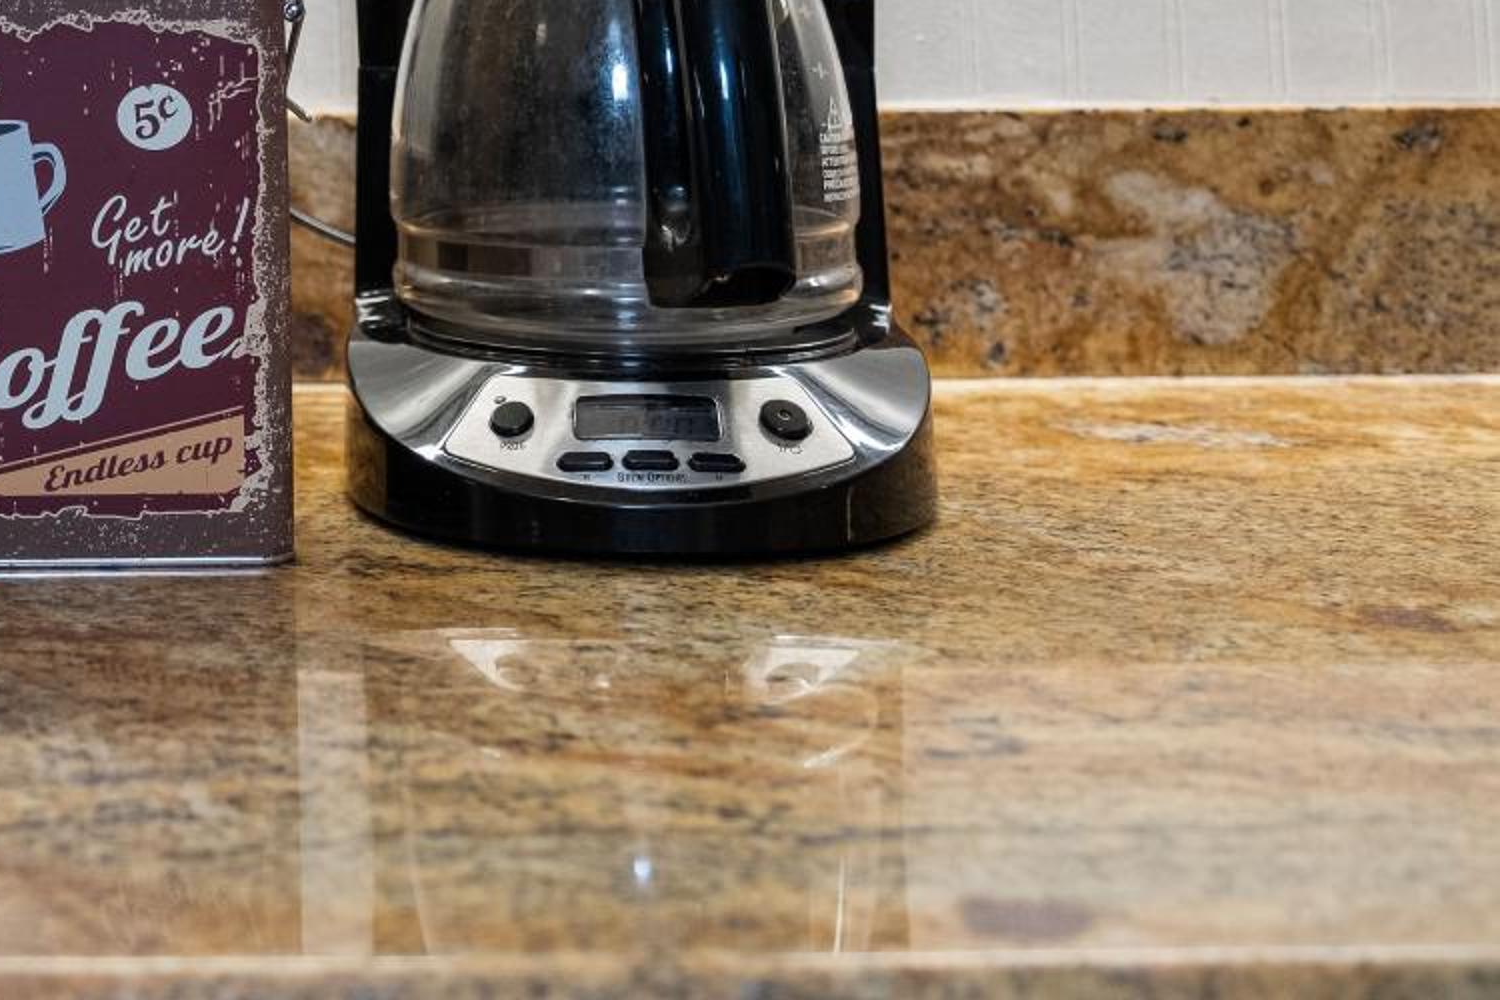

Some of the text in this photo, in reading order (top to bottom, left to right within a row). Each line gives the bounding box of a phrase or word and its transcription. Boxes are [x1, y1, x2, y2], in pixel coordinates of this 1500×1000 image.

[91, 194, 174, 266] Get
[124, 197, 250, 277] more!
[43, 435, 234, 492] Endless cup
